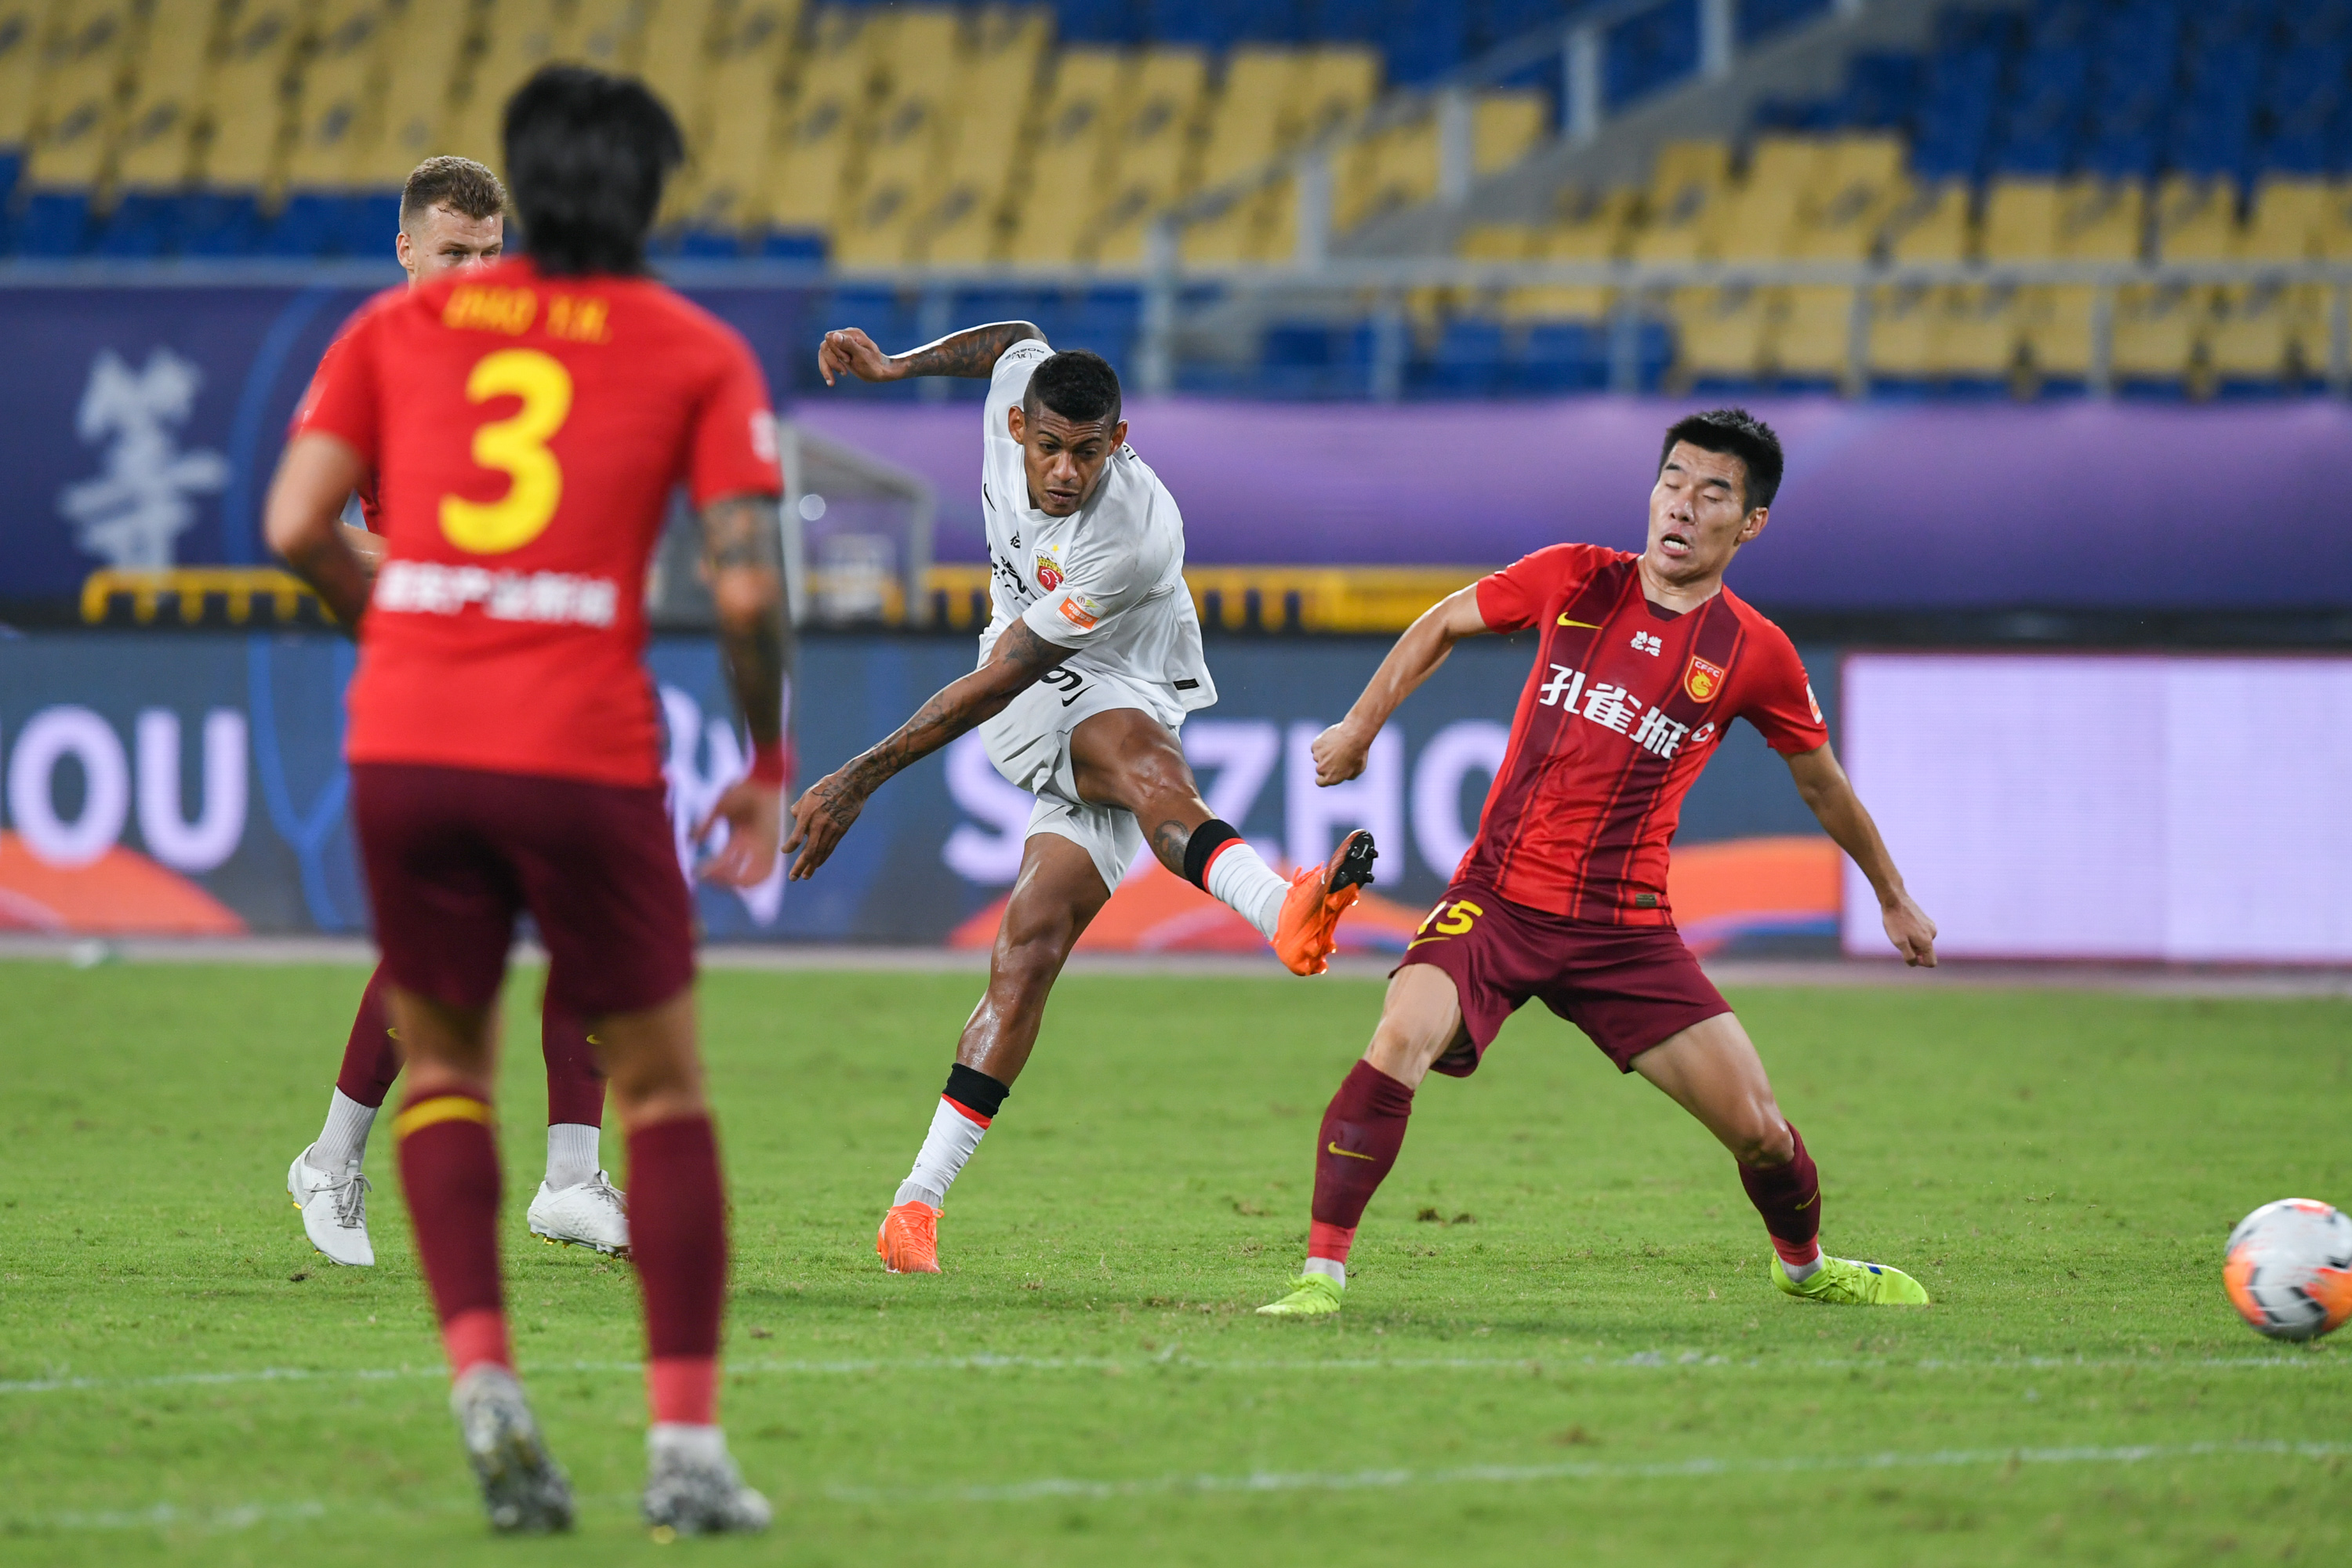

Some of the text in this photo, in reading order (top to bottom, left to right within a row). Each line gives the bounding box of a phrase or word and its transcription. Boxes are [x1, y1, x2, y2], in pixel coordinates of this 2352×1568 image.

[438, 347, 573, 554] 3
[1539, 662, 1690, 760] 孔雀城
[1694, 660, 1720, 677] CFFC
